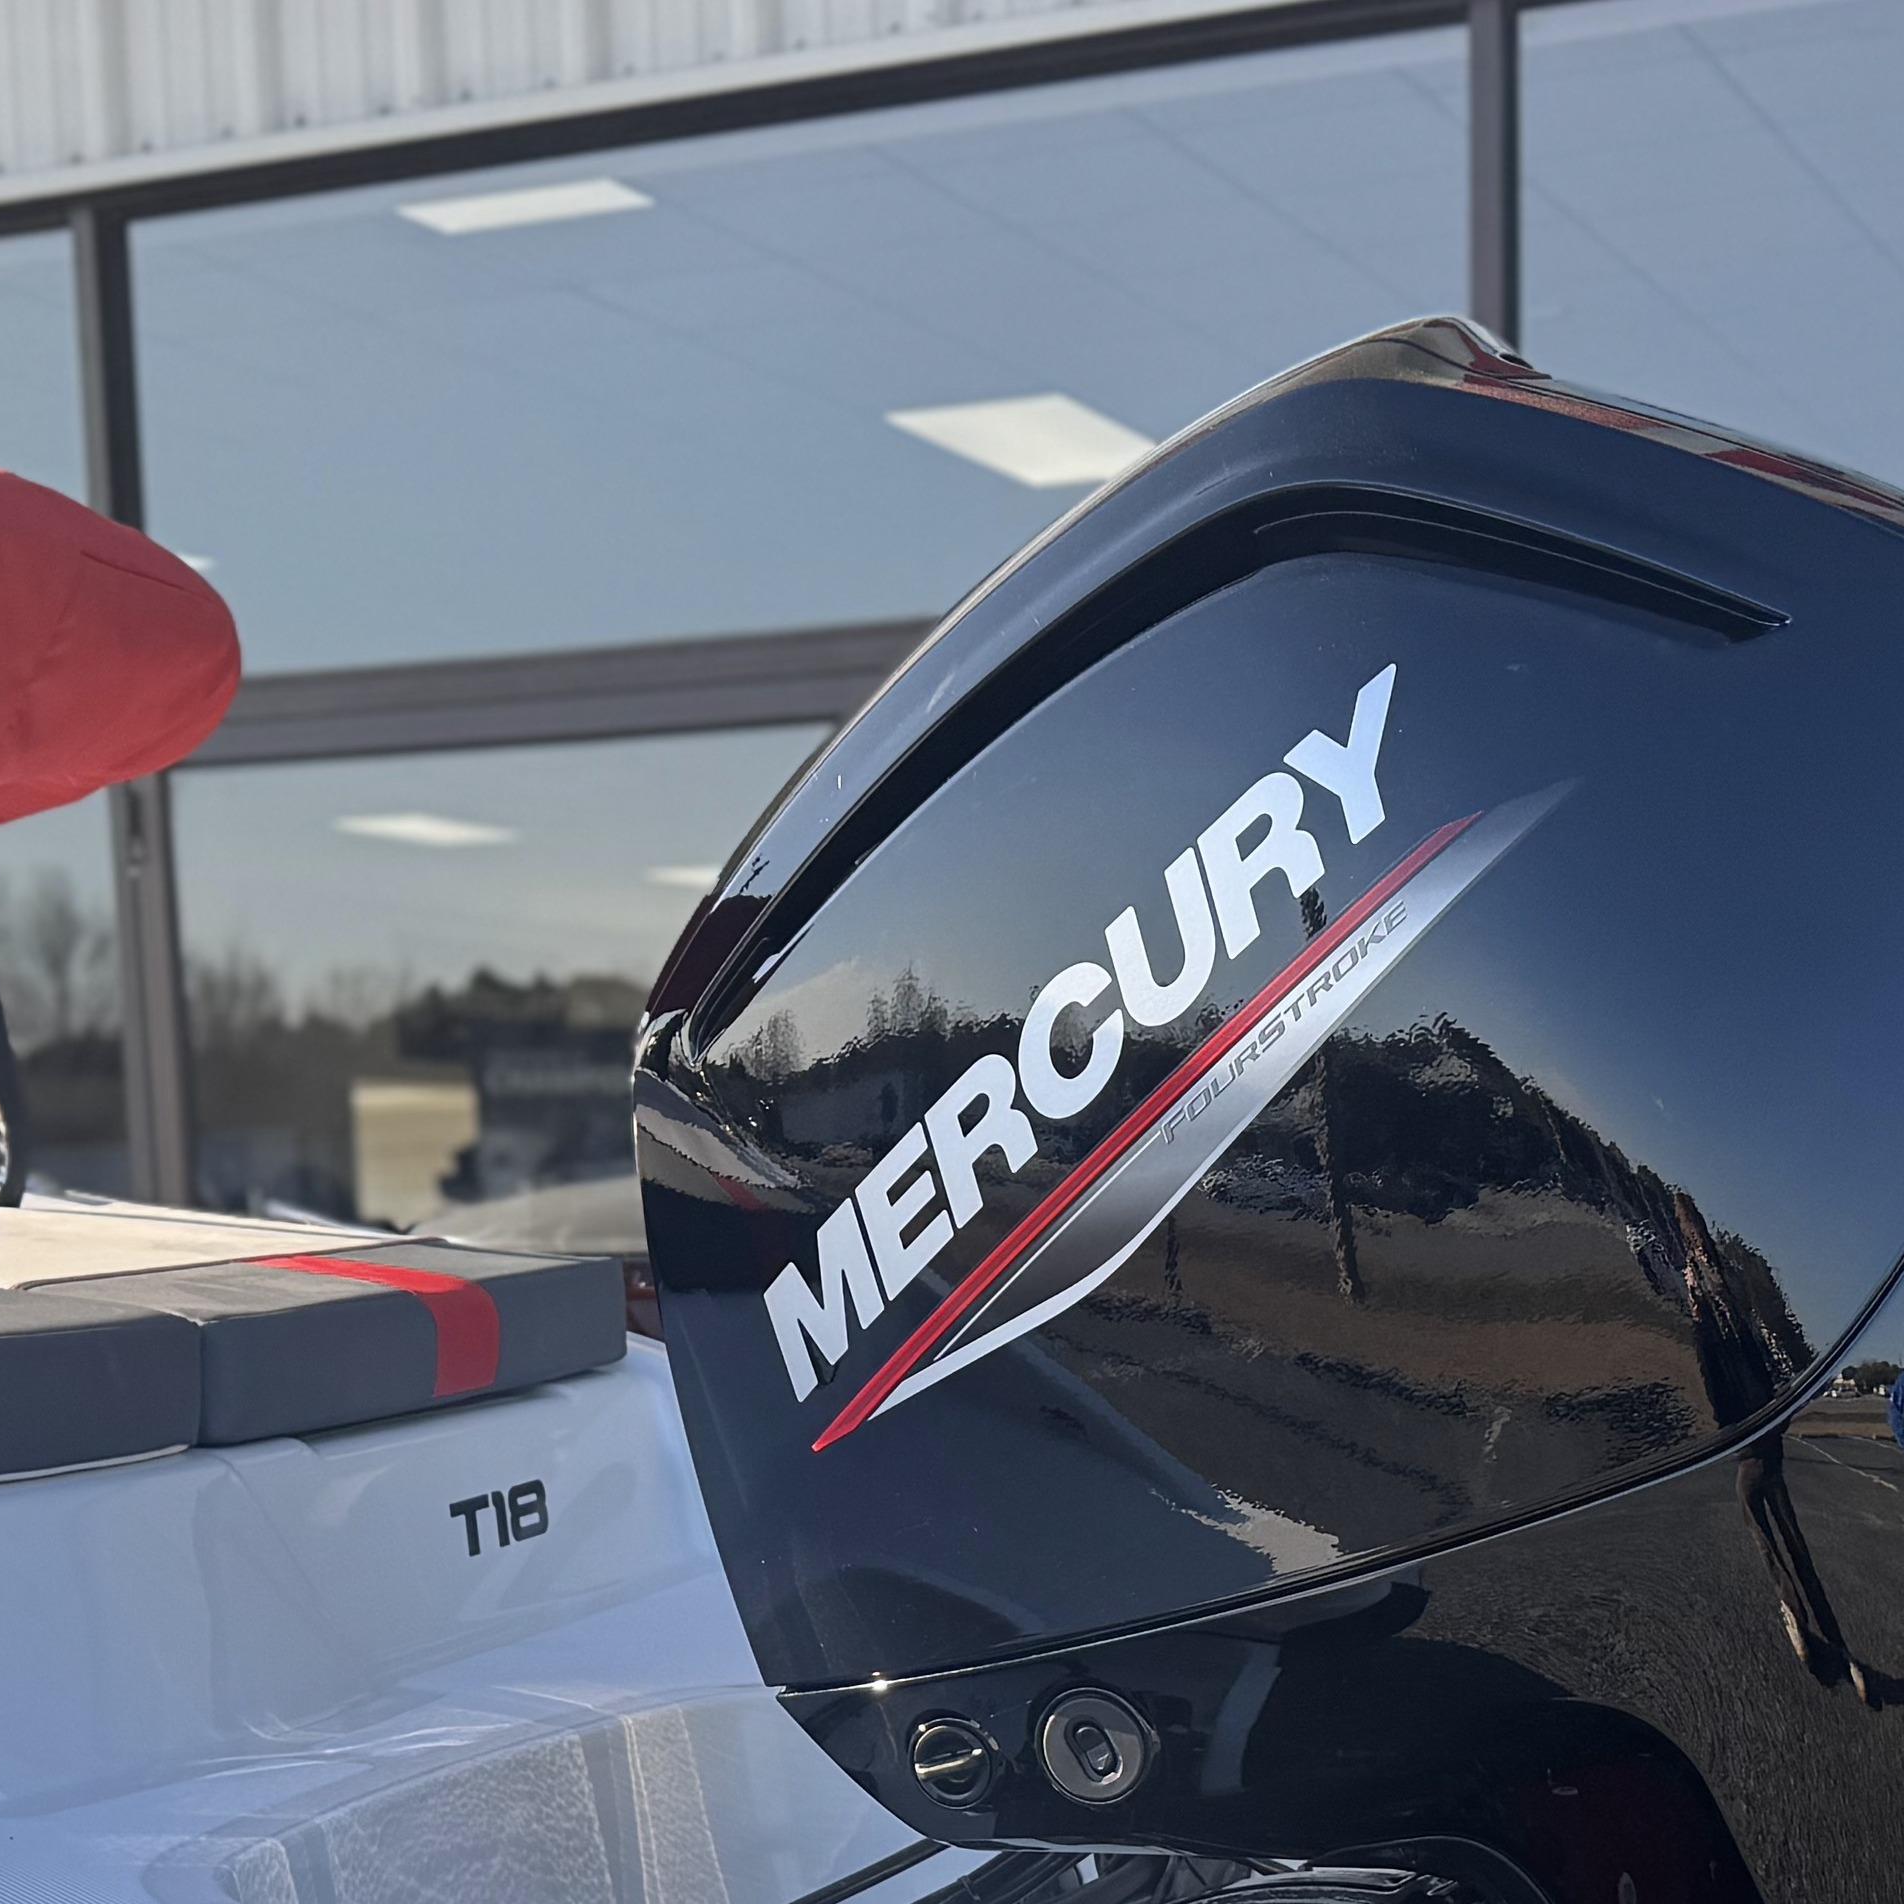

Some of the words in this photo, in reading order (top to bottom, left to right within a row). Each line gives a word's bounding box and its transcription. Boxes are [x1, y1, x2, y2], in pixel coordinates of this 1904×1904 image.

[763, 663, 1397, 1402] MERCURY
[1159, 899, 1408, 1144] FOURSTROKE
[449, 1479, 549, 1557] T18
